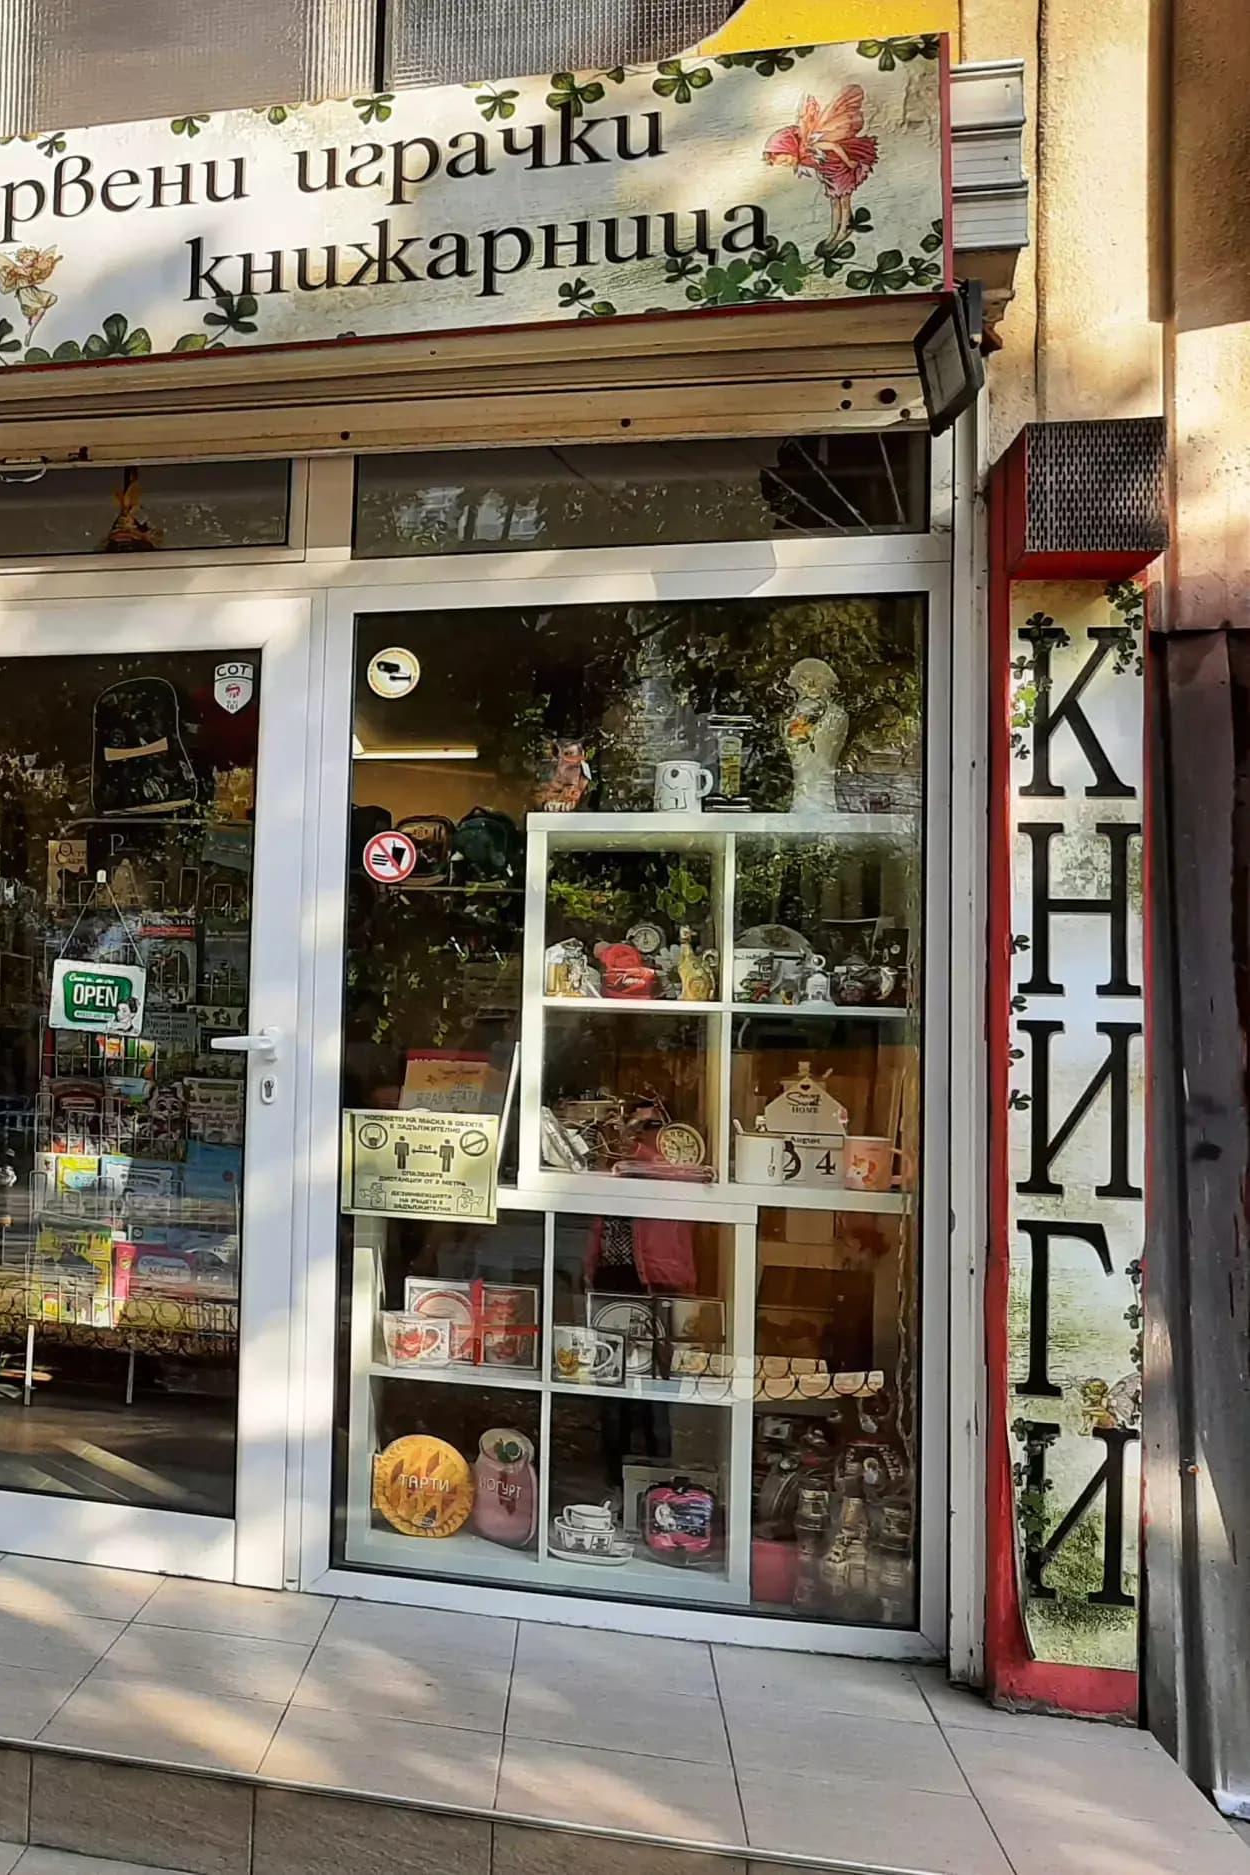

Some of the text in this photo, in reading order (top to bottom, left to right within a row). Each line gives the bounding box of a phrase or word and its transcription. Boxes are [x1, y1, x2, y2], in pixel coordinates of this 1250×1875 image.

[294, 98, 665, 205] играчки
[184, 199, 774, 304] книжарница
[73, 983, 119, 1007] OPEN
[1017, 625, 1142, 1606] КНИГИ
[815, 1150, 836, 1176] 4
[398, 1473, 450, 1492] ТАРТИ
